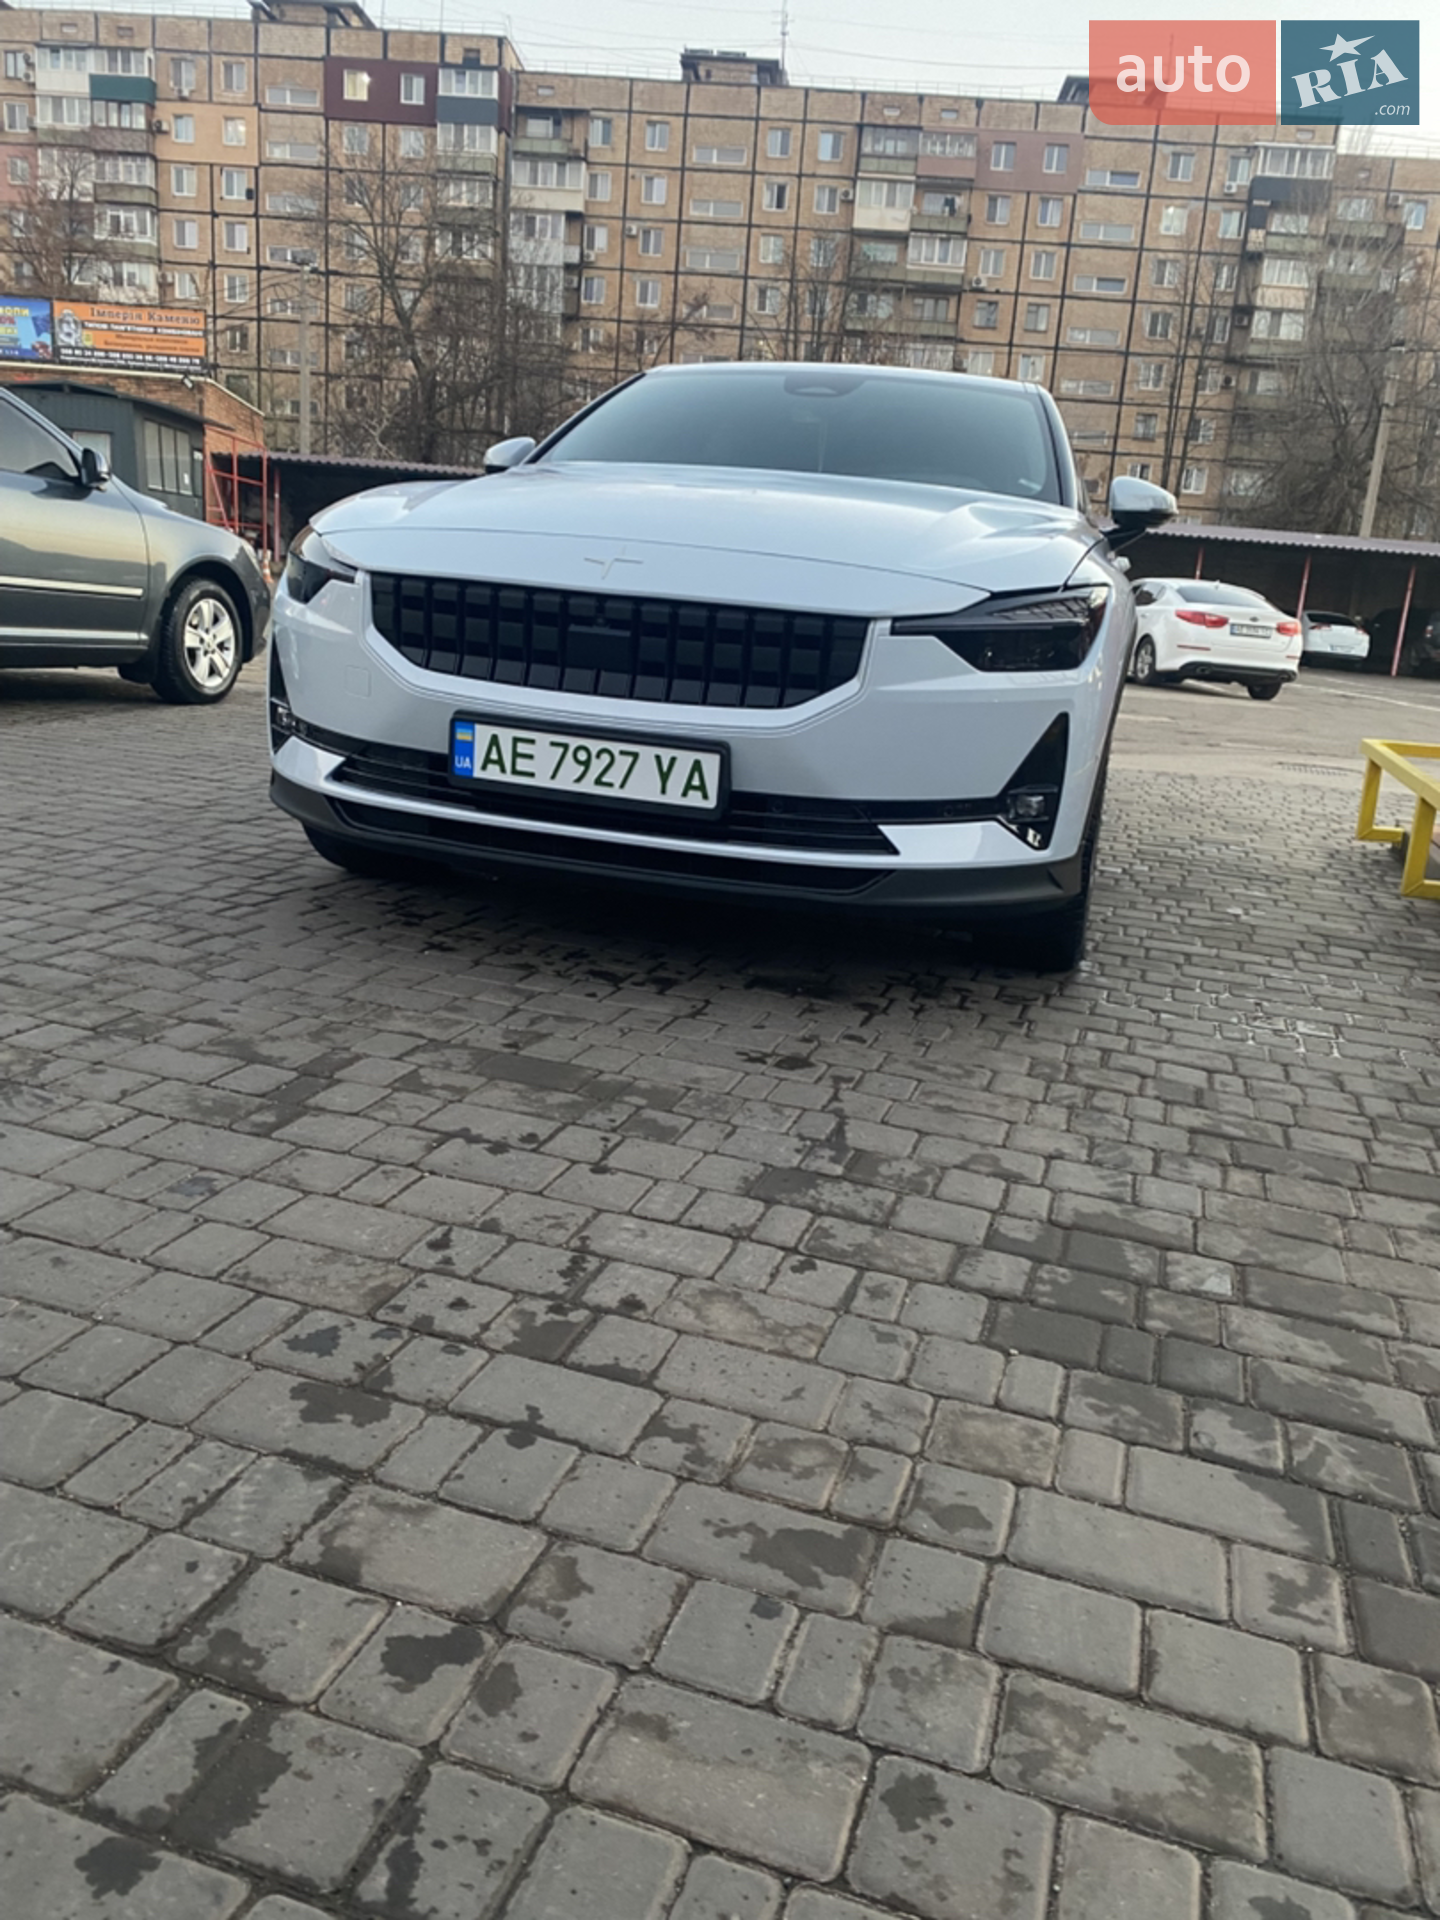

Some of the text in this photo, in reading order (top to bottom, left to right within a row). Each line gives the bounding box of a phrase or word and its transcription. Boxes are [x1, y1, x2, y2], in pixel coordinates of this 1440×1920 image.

[147, 311, 201, 325] Каменю
[455, 755, 472, 770] UA
[480, 733, 710, 800] AE 7927 YA
